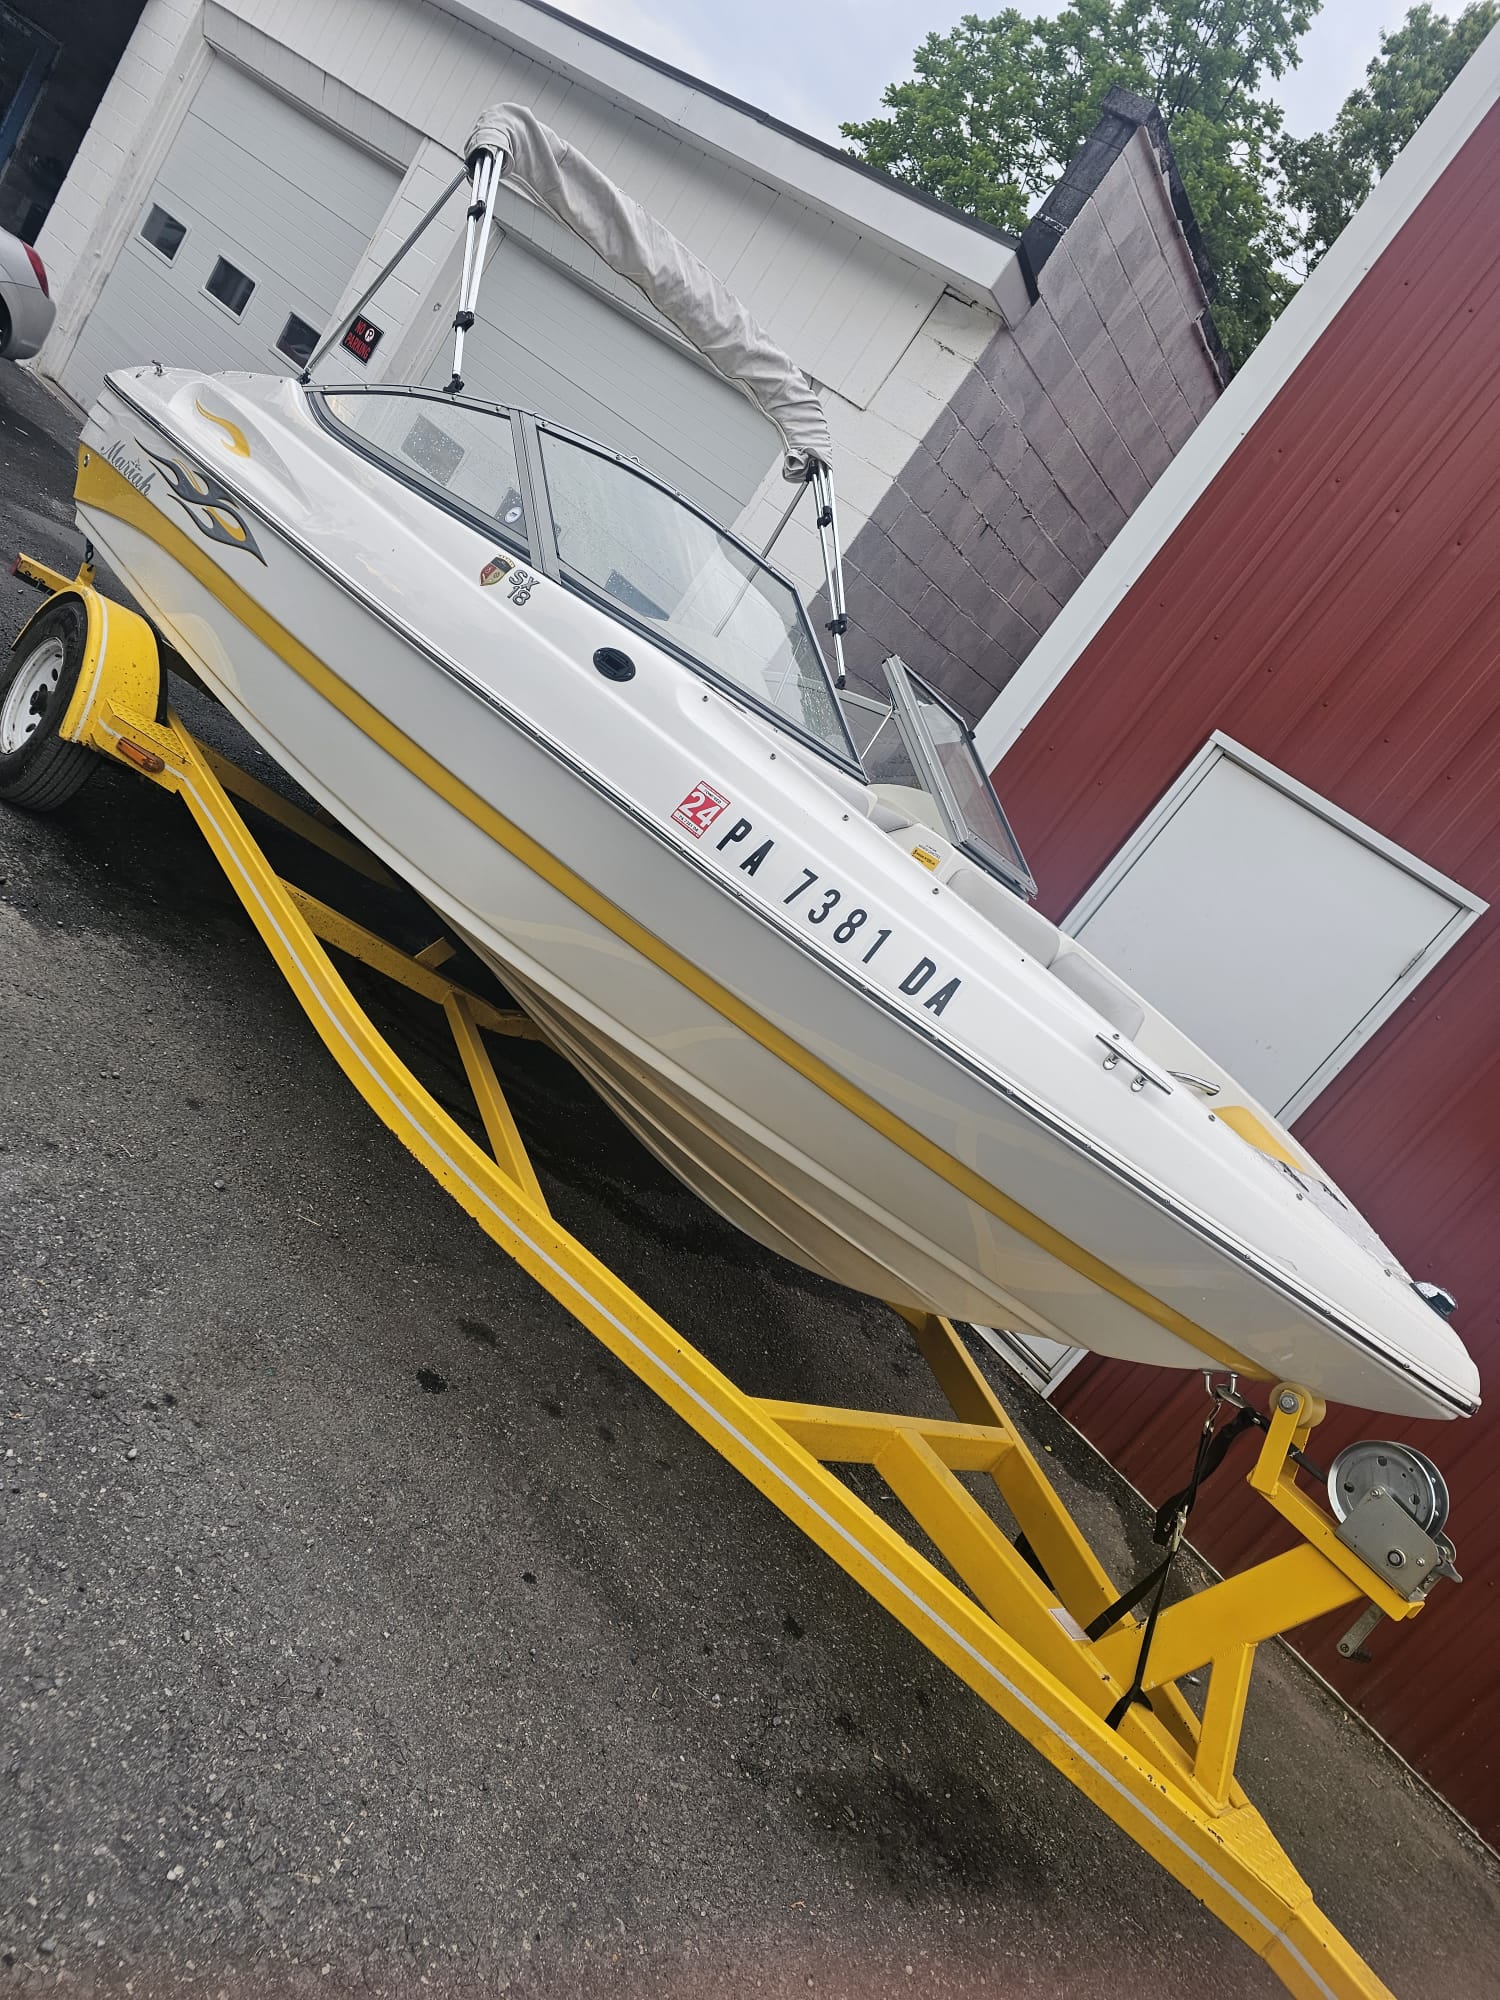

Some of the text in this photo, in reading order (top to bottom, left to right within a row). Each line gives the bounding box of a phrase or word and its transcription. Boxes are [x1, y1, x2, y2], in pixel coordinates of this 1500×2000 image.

[354, 320, 366, 336] NO
[344, 331, 371, 360] PARKING
[100, 439, 156, 497] Mariah
[508, 569, 540, 592] SX
[507, 585, 531, 606] 18
[678, 791, 721, 828] 24
[716, 818, 962, 1017] PA 7381 DA
